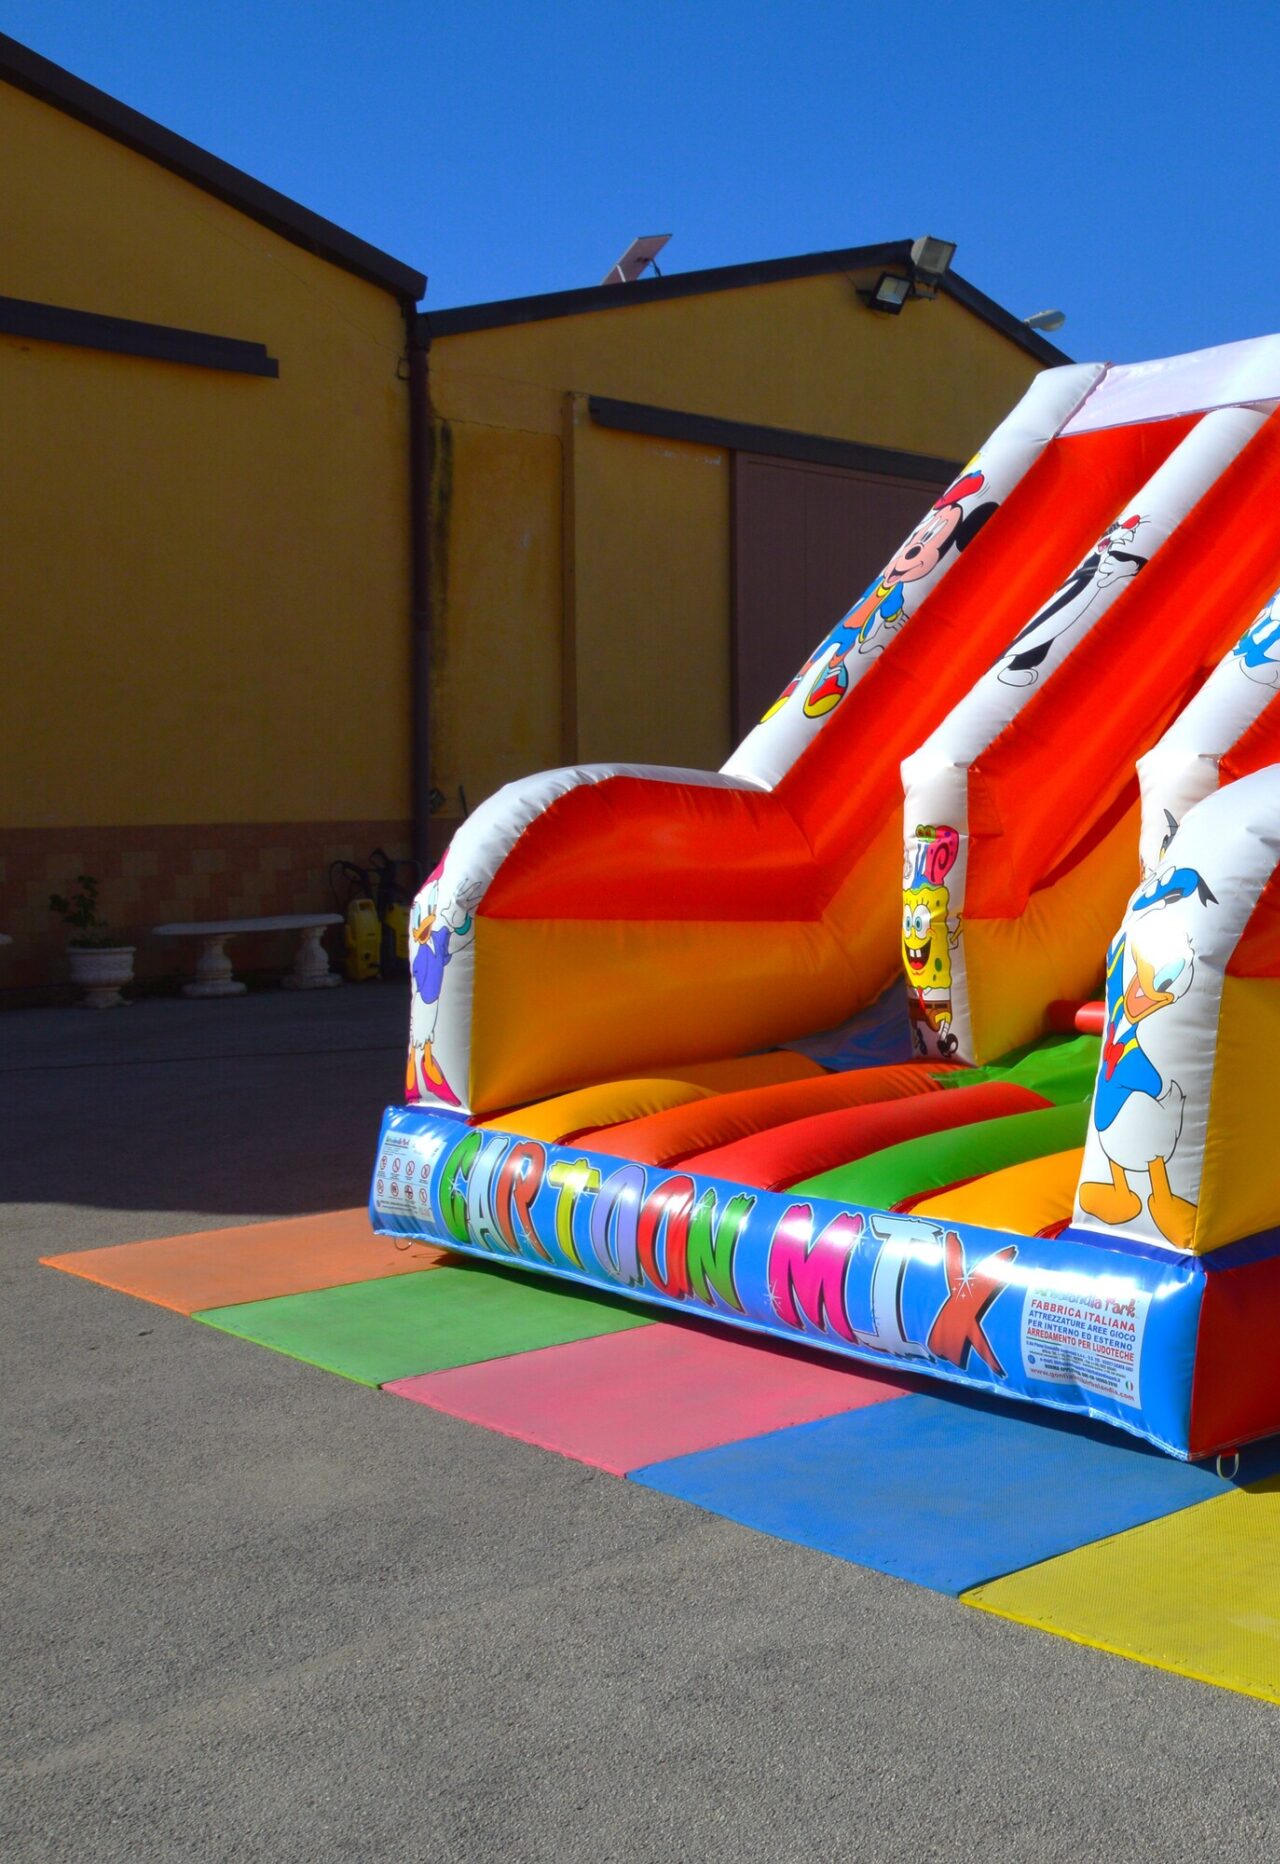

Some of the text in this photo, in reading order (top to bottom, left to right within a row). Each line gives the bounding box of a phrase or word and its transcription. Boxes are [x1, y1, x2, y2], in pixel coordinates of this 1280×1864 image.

[439, 1131, 1018, 1378] CARTOON MIX
[1029, 1310, 1136, 1342] ATTREZZATURE AREE GIOCO
[1031, 1299, 1136, 1333] FABBRICA ITALIANA
[1027, 1327, 1076, 1346] ARREDAMENTO
[1078, 1340, 1091, 1349] PER
[1093, 1343, 1135, 1360] LUDOTECHE
[1028, 1318, 1133, 1351] PER INTERNO ED ESTERNO
